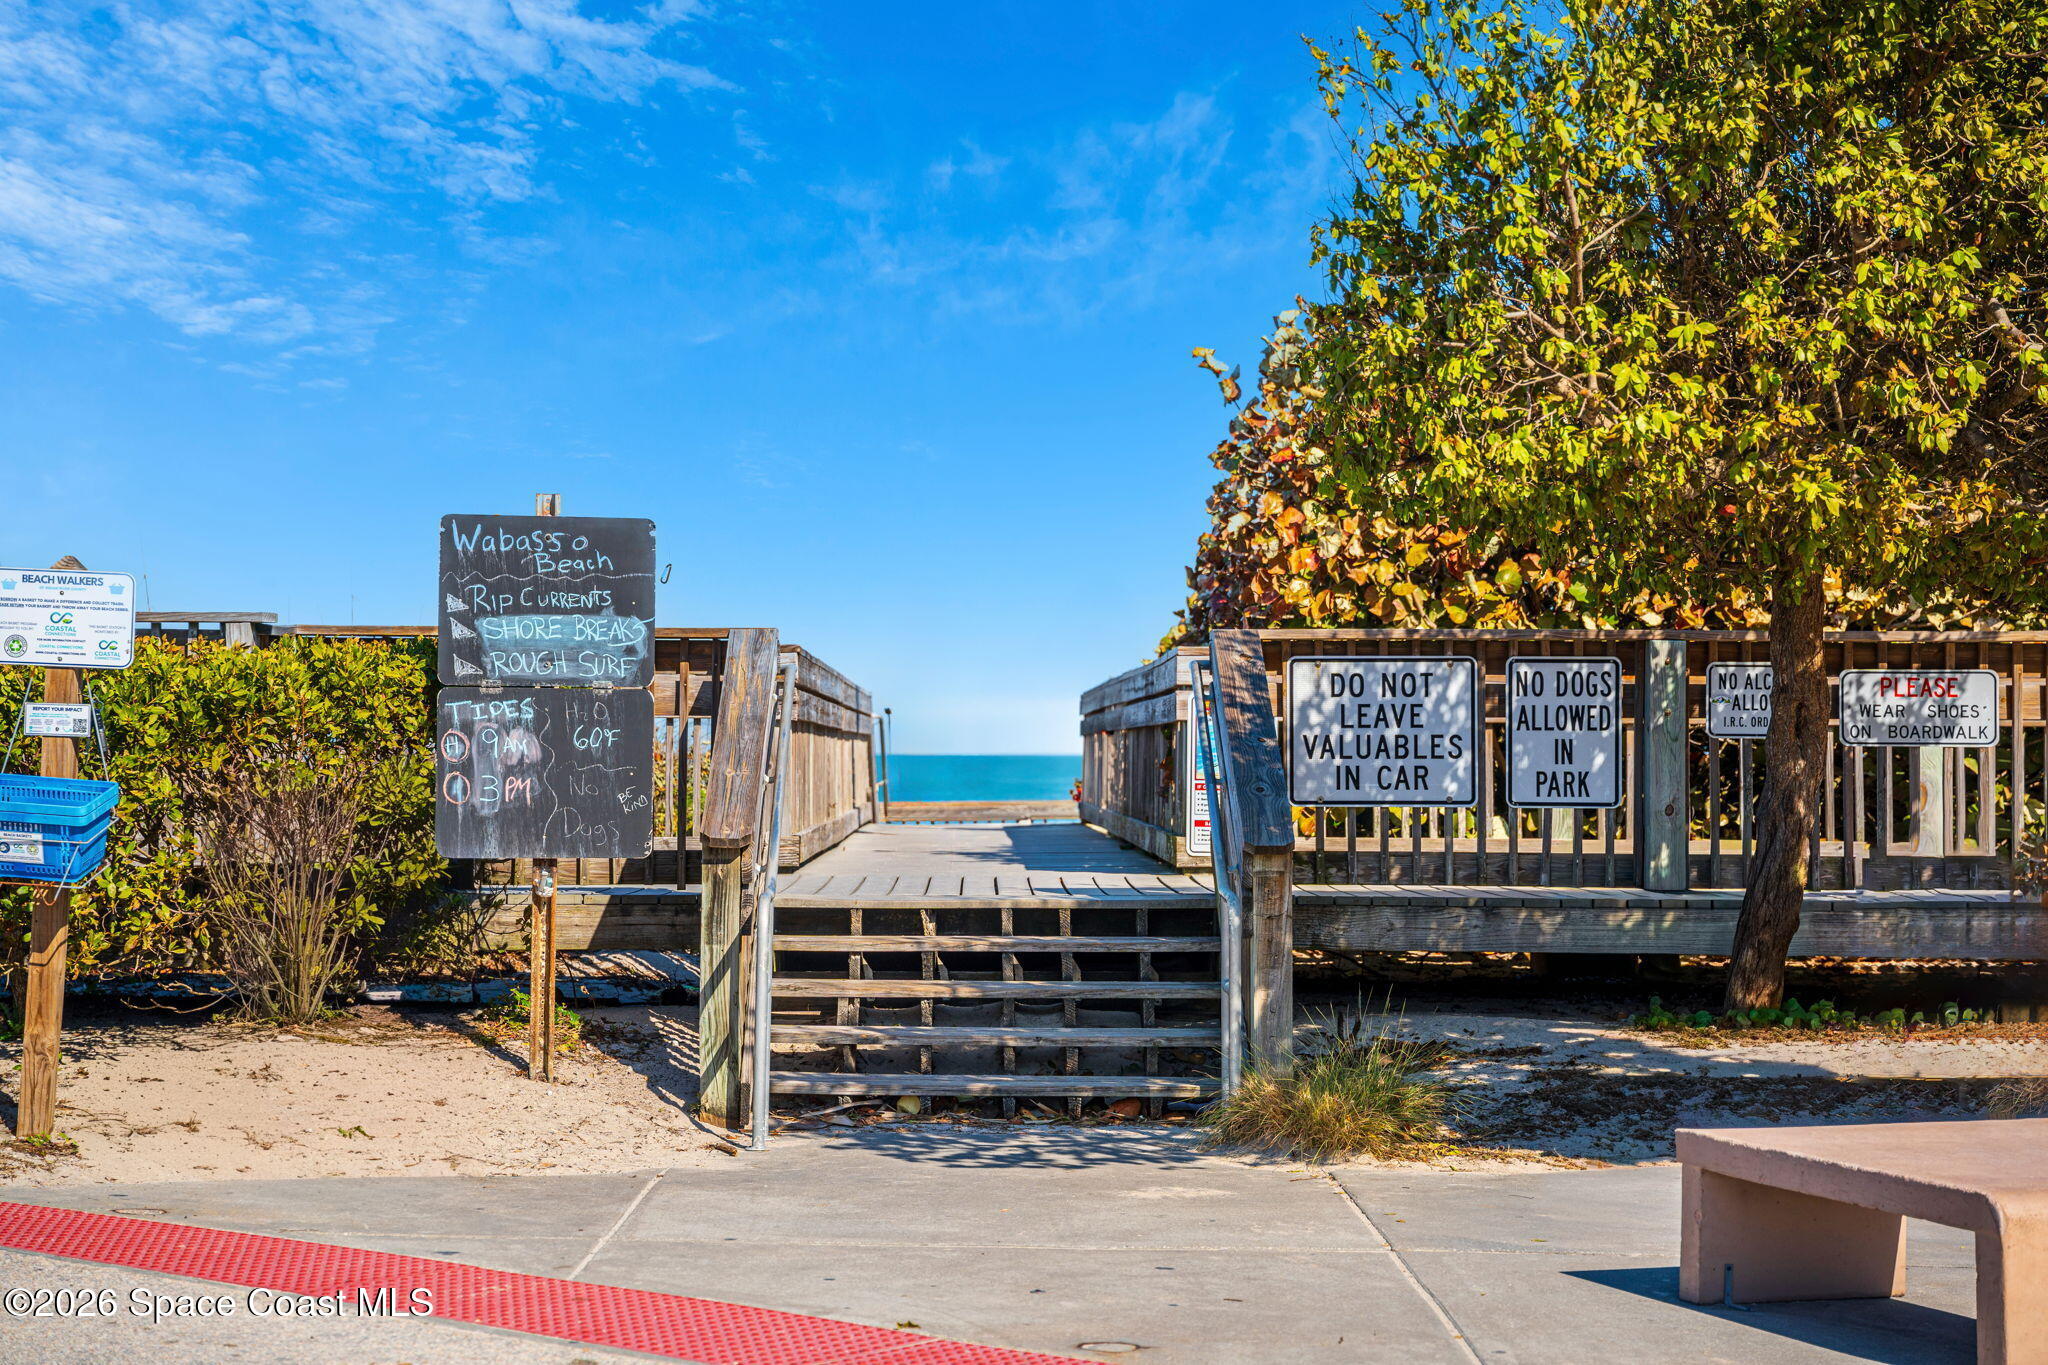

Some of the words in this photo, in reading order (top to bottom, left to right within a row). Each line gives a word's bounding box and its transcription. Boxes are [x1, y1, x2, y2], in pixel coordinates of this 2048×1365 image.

[452, 520, 589, 552] Wabasso
[532, 549, 614, 573] Beach
[22, 574, 54, 584] BEACH
[57, 576, 104, 587] WALKERS
[482, 616, 564, 640] SHORE
[573, 614, 655, 646] BREAKS
[490, 651, 566, 678] ROUGH
[579, 651, 637, 678] SURF
[1330, 672, 1365, 698] DO
[1381, 672, 1434, 698] NOT
[1516, 671, 1545, 697] NO
[1555, 671, 1613, 697] DOGS
[1718, 672, 1738, 690] NO
[1880, 677, 1959, 698] PLEASE
[445, 697, 535, 720] TIDES
[1340, 703, 1424, 729] LEAVE
[1516, 704, 1612, 732] ALLOWED
[1859, 704, 1906, 718] WEAR
[1927, 704, 1980, 718] SHOES
[1723, 716, 1747, 728] I.R.C.
[1849, 725, 1872, 739] ON
[1888, 725, 1989, 739] BOARDWALK
[446, 734, 459, 754] H
[481, 728, 499, 759] 9
[503, 737, 528, 755] AM
[1302, 734, 1463, 760] VALUABLES
[1554, 738, 1574, 765] IN
[480, 775, 500, 802] 3
[505, 776, 532, 806] PM
[1335, 765, 1361, 791] IN
[1376, 765, 1429, 791] CAR
[1535, 771, 1591, 798] PARK
[616, 785, 636, 802] BE
[622, 794, 649, 815] KIND
